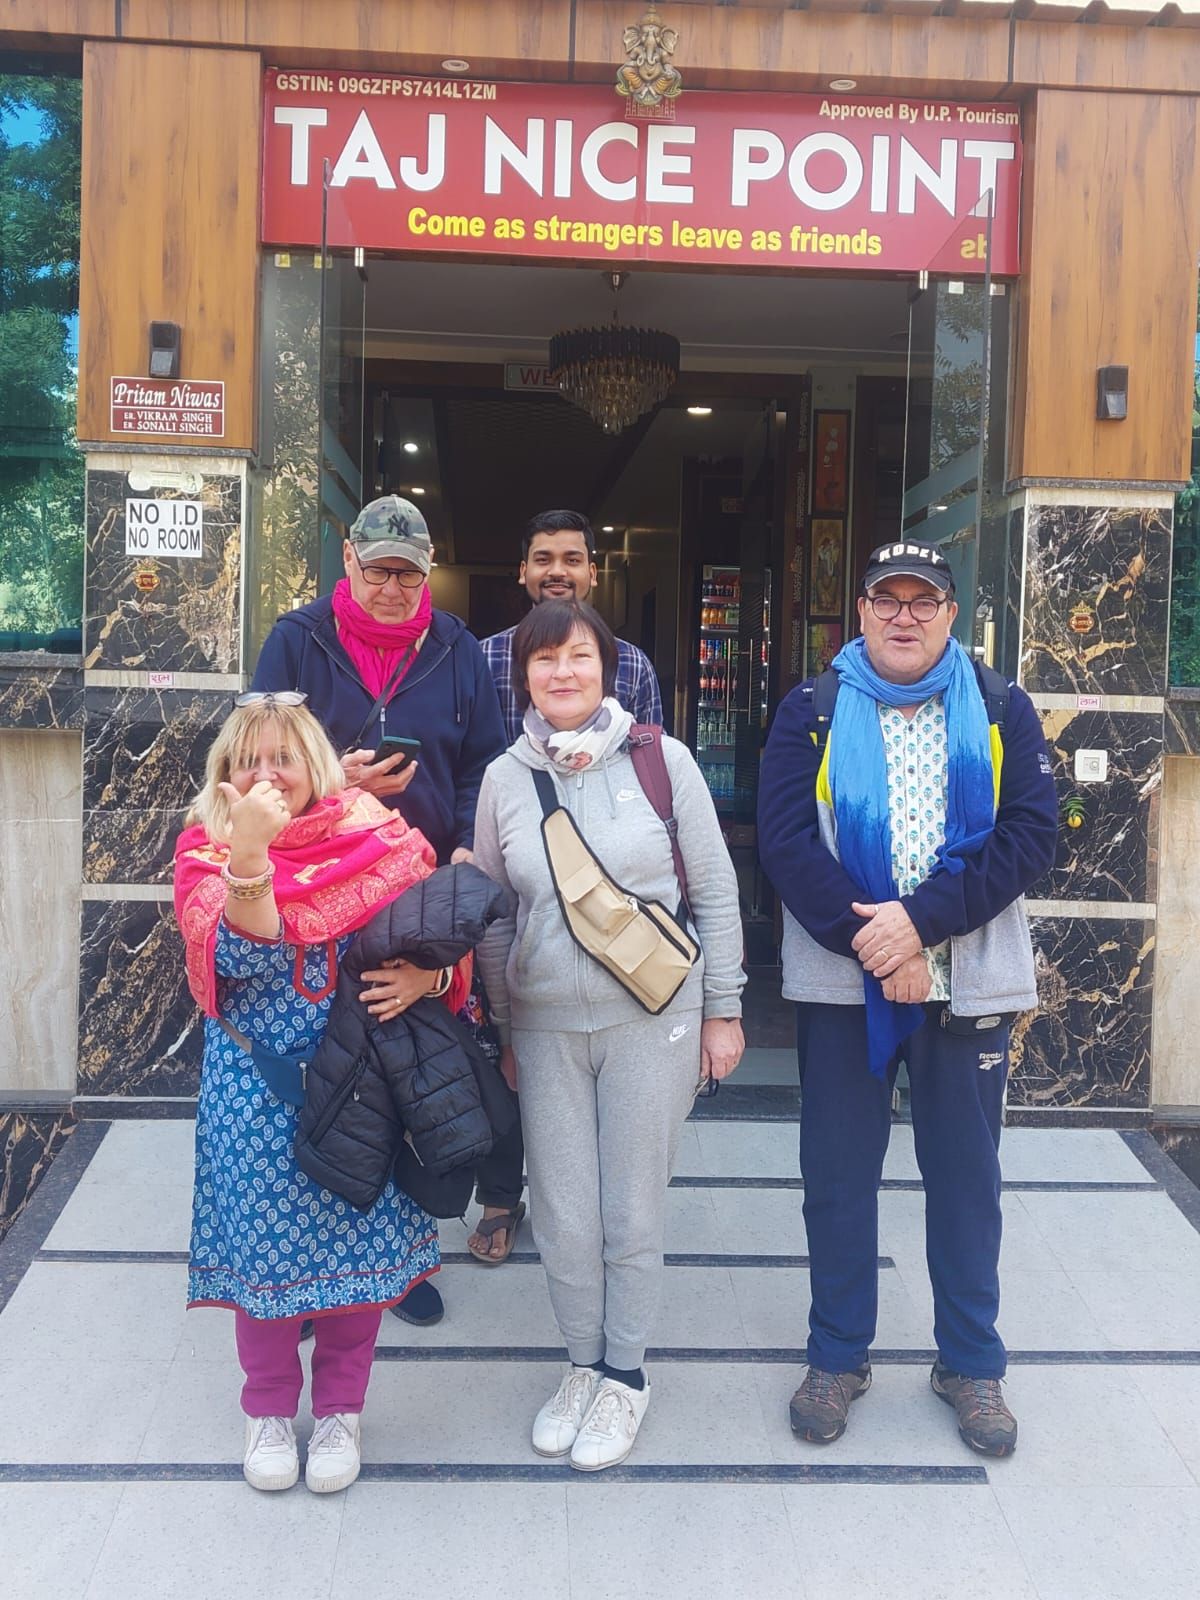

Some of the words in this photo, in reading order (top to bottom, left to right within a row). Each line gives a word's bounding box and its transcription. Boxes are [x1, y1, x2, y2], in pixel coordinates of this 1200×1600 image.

[276, 75, 333, 92] GSTIN:
[338, 77, 497, 100] 09GZFPS7414L1ZM
[819, 100, 893, 121] Approved
[899, 103, 918, 124] By
[923, 107, 952, 123] U.P.
[957, 109, 1019, 126] Tourism
[274, 106, 446, 192] TAJ
[484, 114, 696, 205] NICE
[731, 128, 1015, 219] POINT
[408, 207, 486, 236] Come
[493, 218, 526, 240] as
[534, 215, 664, 251] strangers
[671, 220, 743, 250] leave
[751, 230, 782, 251] as
[789, 225, 882, 256] friends
[114, 383, 167, 406] Pritam
[170, 384, 221, 408] Niwas
[137, 411, 178, 422] VIKRAM
[181, 412, 213, 423] SINGH
[137, 421, 176, 432] SONALI
[179, 422, 213, 433] SINGH
[129, 503, 160, 524] NO
[172, 504, 198, 526] I.D
[128, 528, 149, 548] NO
[157, 529, 200, 550] ROOM
